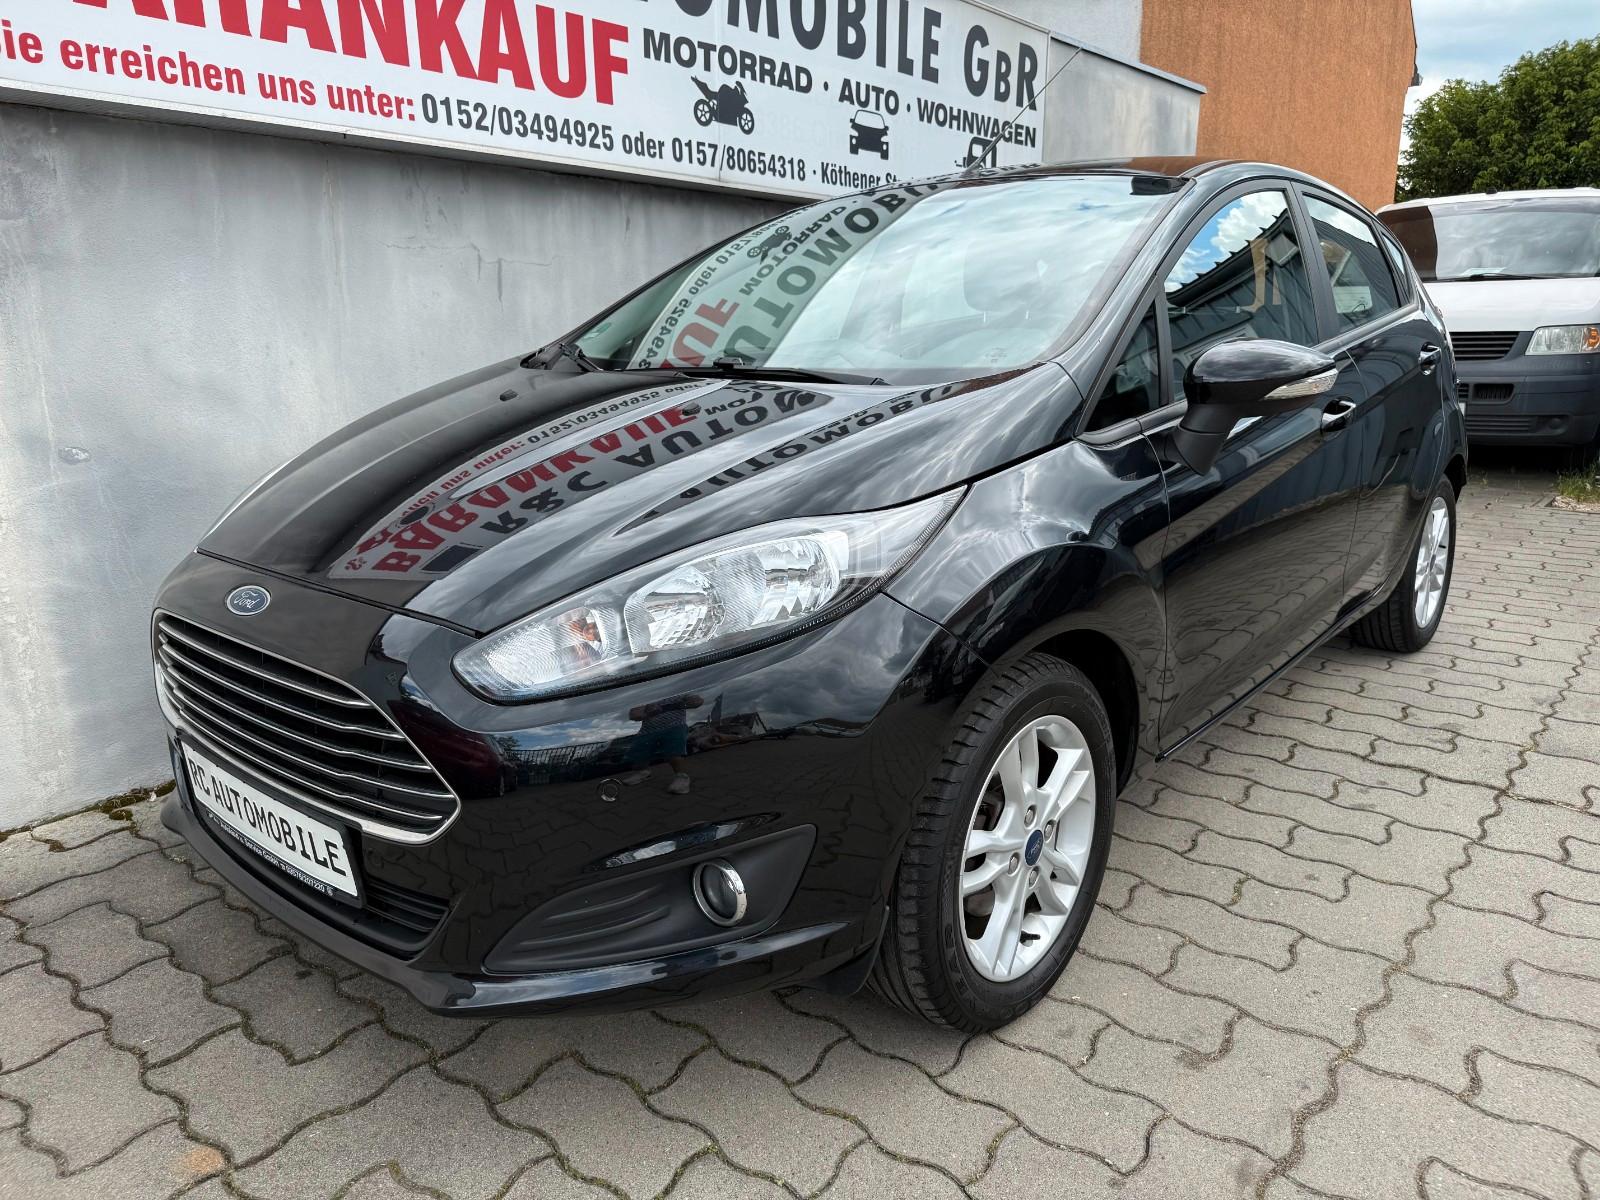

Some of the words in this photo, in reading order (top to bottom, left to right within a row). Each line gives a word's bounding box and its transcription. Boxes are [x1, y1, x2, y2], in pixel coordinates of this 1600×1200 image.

[0, 19, 44, 64] ie
[60, 40, 245, 94] erreichen
[258, 73, 316, 105] uns
[327, 85, 415, 121] unter:
[422, 93, 614, 152] 0152/03494925
[622, 132, 665, 159] oder
[672, 138, 805, 182] 0157/80654318
[821, 162, 881, 189] Köthener
[643, 28, 813, 94] MOTORRAD
[839, 78, 899, 115] AUTO
[917, 98, 1037, 148] WOHNWAGEN
[233, 590, 261, 609] Ford
[188, 758, 211, 796] RC
[211, 775, 347, 877] AUTOMOBILE
